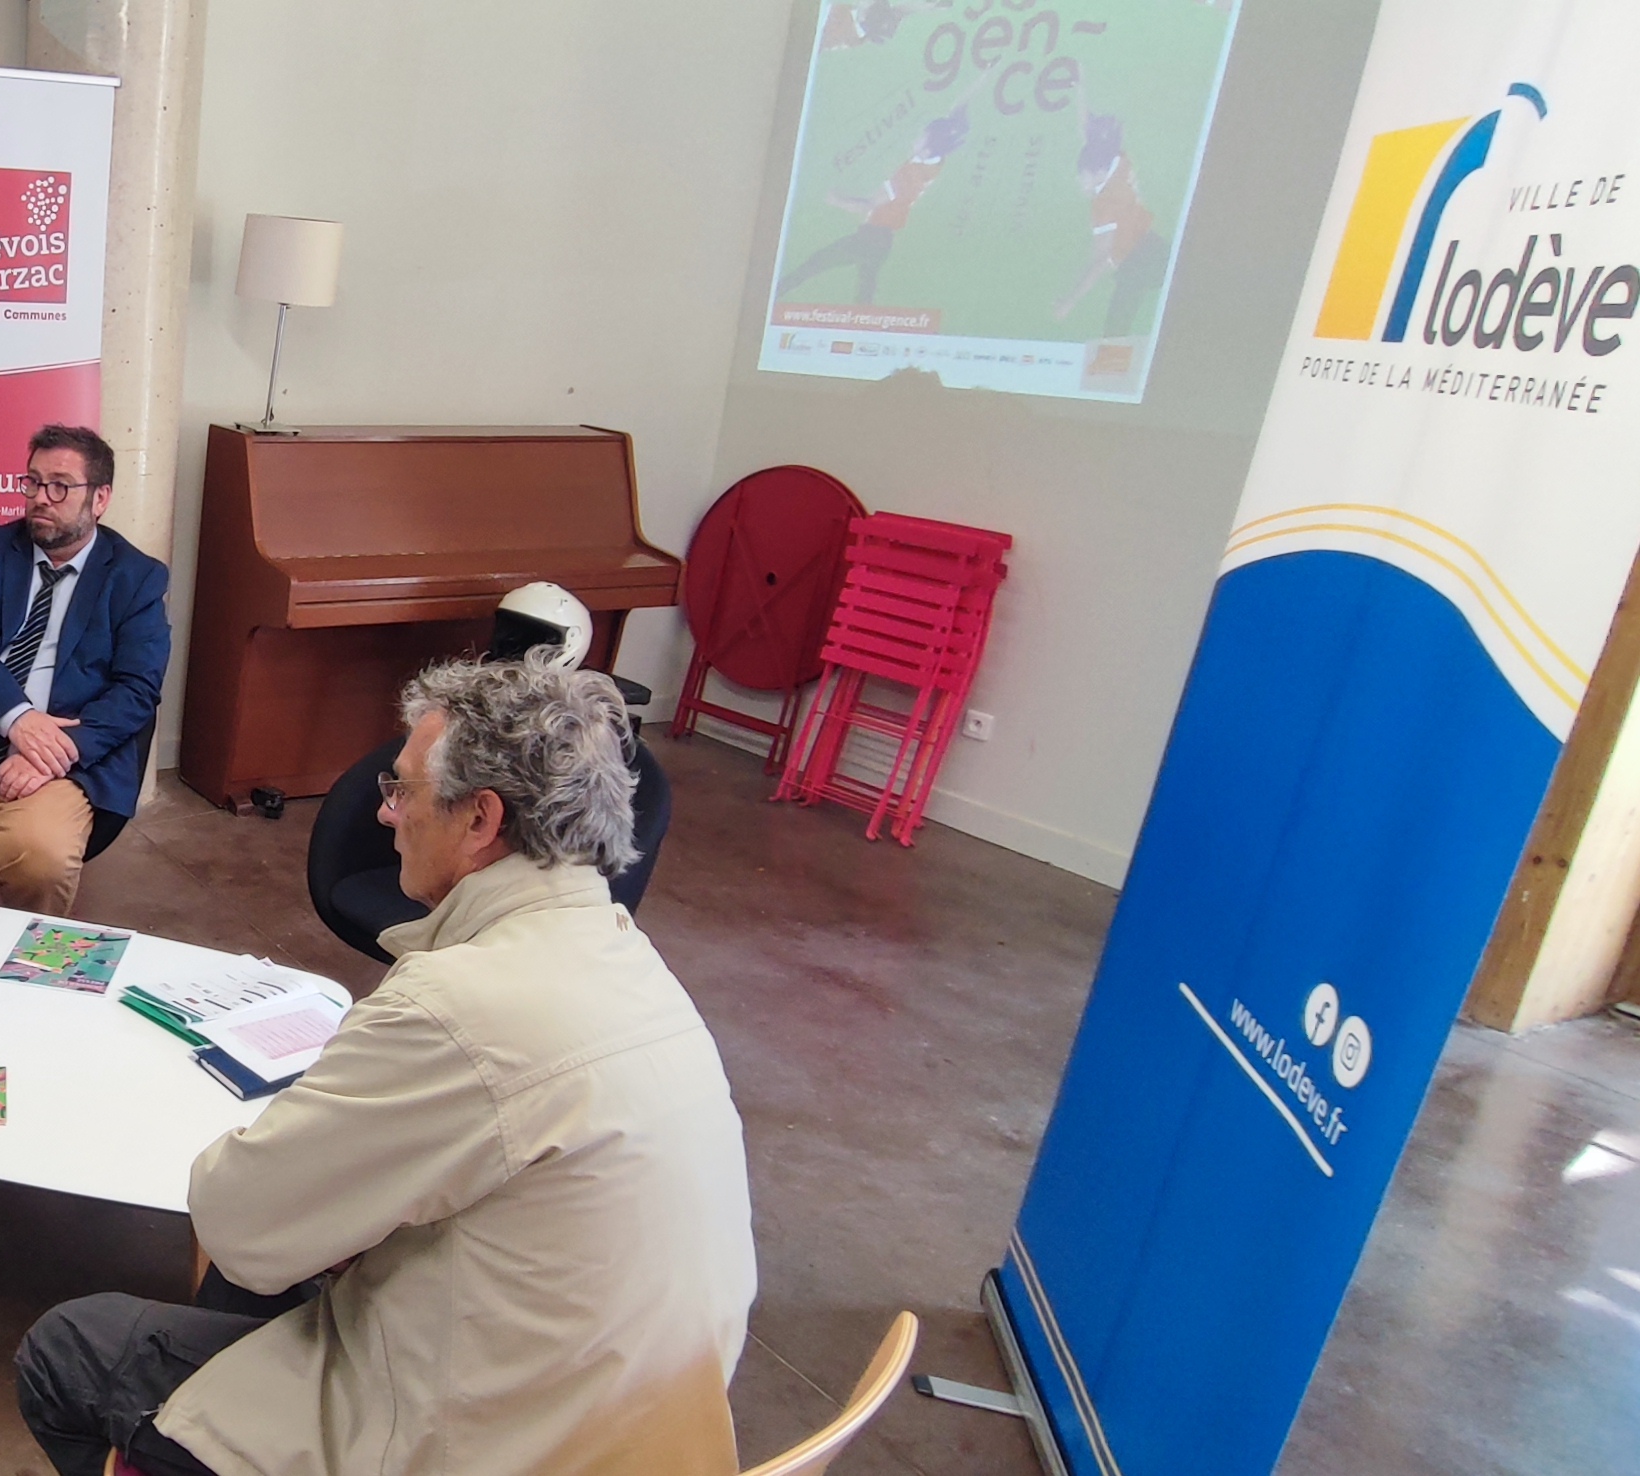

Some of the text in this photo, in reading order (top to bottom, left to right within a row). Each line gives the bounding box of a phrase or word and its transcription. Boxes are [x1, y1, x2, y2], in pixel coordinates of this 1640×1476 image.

[993, 56, 1080, 116] ce
[834, 89, 916, 172] festival
[1509, 174, 1626, 212] VILLE DE
[4, 309, 67, 322] Communes
[1423, 233, 1640, 357] lodève
[1300, 356, 1607, 414] PORTE DE LA MÉDITERRANÉE
[1230, 998, 1348, 1145] www.lodeve.fr
